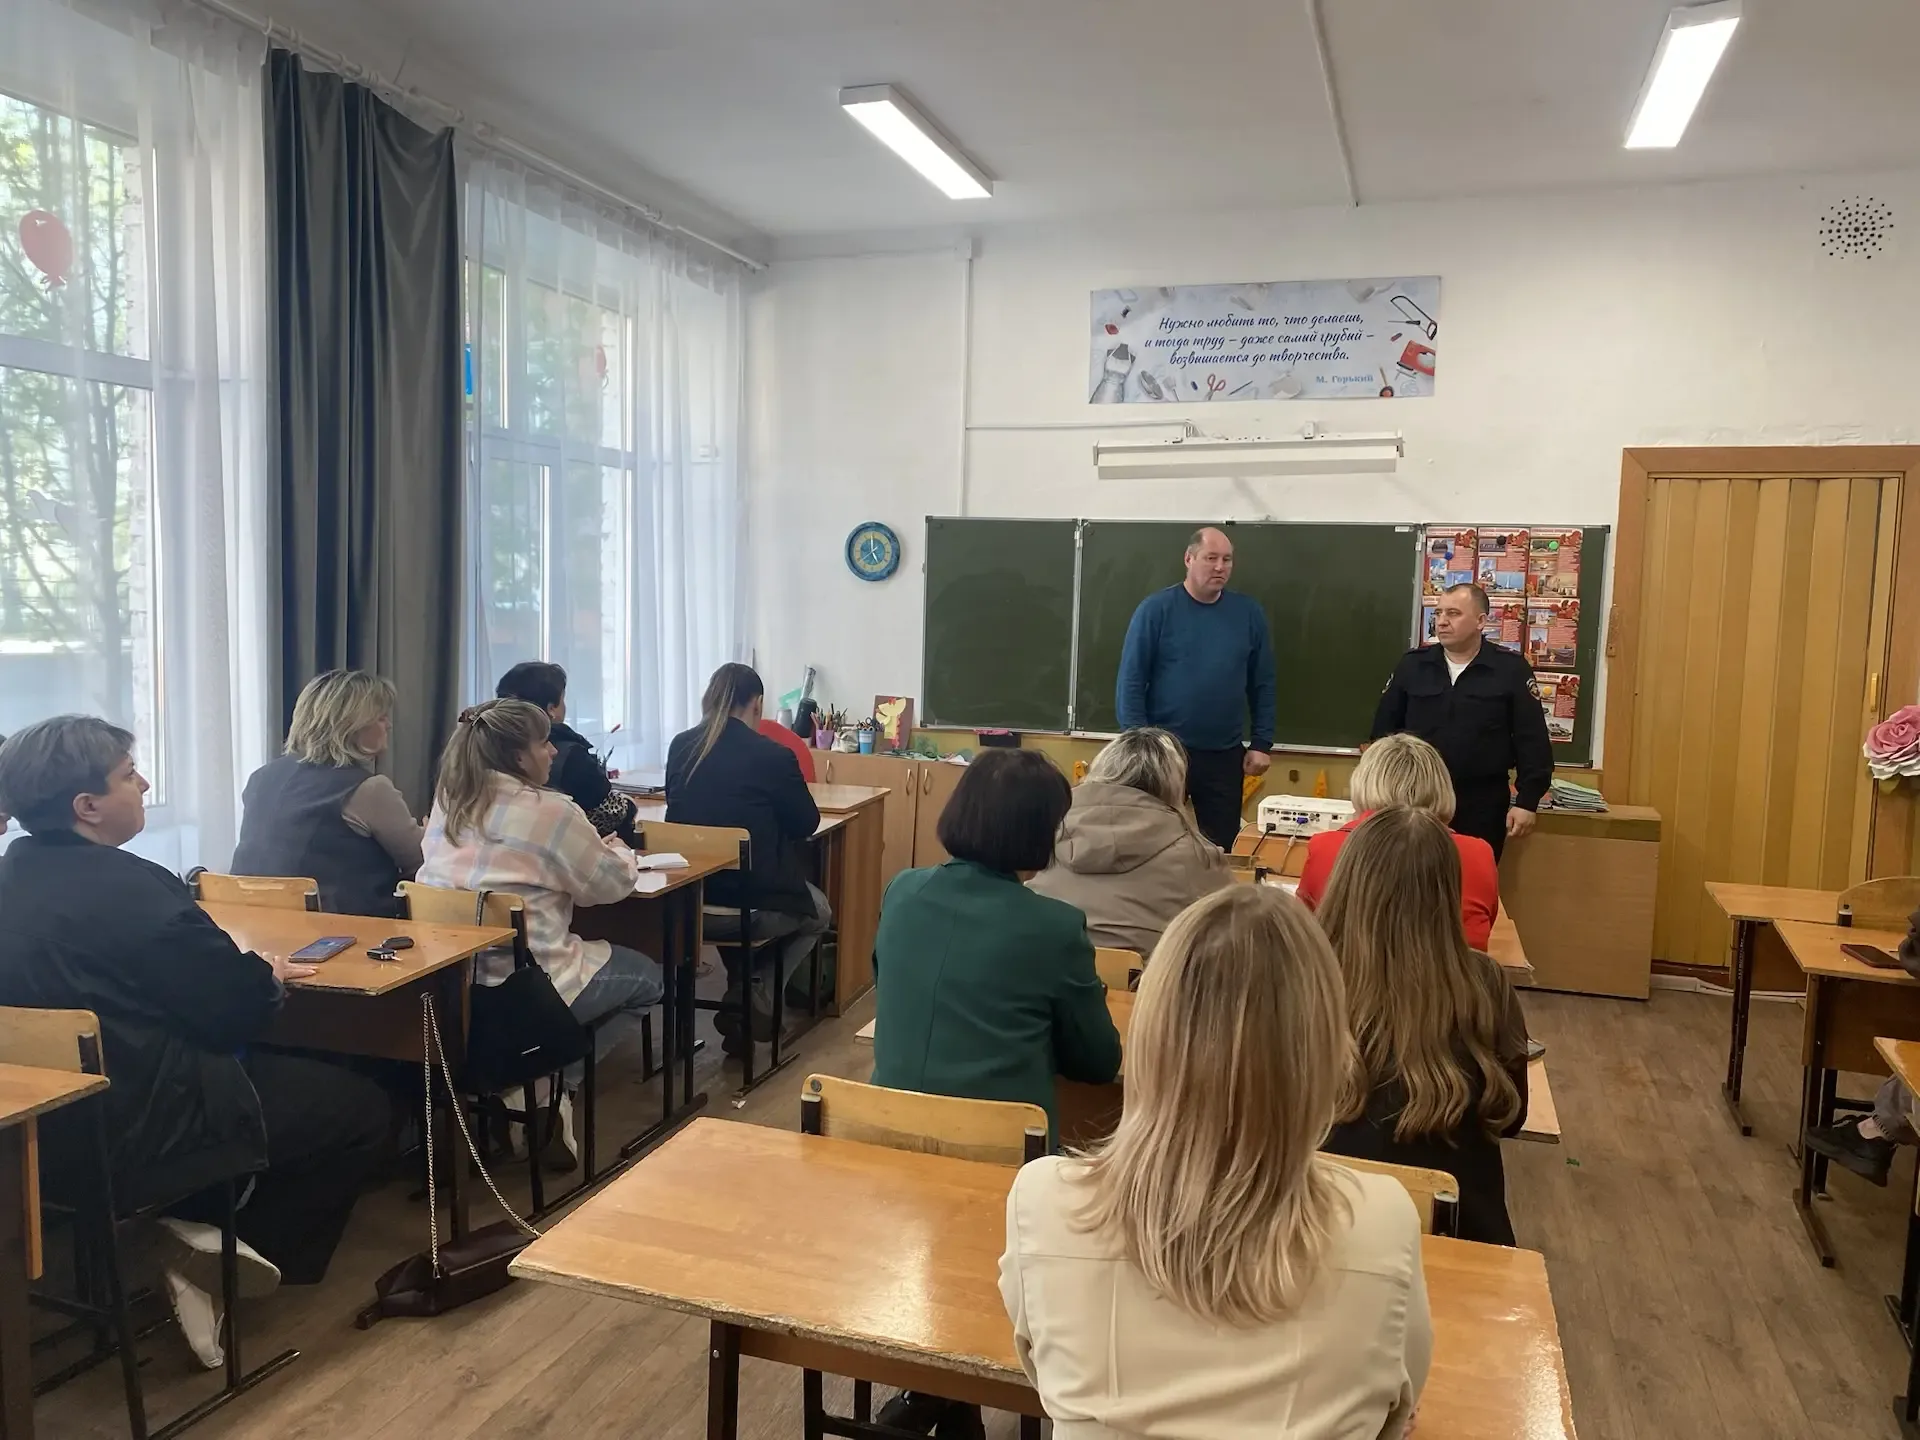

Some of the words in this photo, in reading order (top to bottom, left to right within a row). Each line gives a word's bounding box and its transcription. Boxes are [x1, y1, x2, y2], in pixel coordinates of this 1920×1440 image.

[1159, 317, 1204, 334] Нужно
[1207, 313, 1255, 328] любить
[1258, 316, 1279, 328] то,
[1284, 316, 1308, 325] что
[1309, 314, 1364, 329] делаешь,
[1145, 339, 1152, 348] и
[1154, 337, 1189, 351] тогда
[1192, 336, 1226, 350] труд
[1239, 335, 1275, 350] даже
[1277, 331, 1318, 344] самый
[1319, 327, 1363, 347] грубый
[1169, 350, 1249, 369] возвышается
[1250, 353, 1266, 368] до
[1269, 347, 1349, 366] творчества.
[1315, 375, 1328, 383] М.
[1331, 374, 1374, 385] Горький
